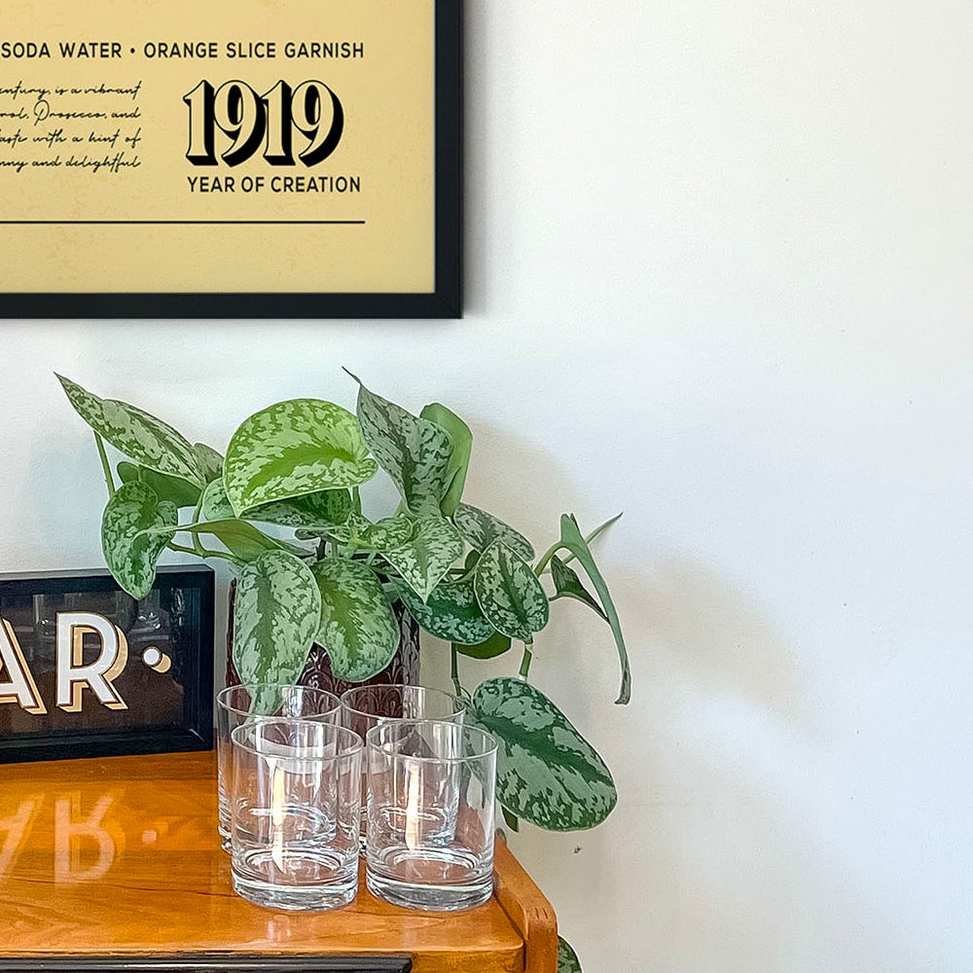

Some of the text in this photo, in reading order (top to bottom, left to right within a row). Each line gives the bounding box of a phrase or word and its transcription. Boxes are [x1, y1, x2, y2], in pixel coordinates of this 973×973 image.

[1, 42, 51, 59] SODA
[58, 42, 122, 59] WATER
[143, 42, 218, 59] ORANGE
[226, 42, 276, 59] SLICE
[284, 42, 364, 59] GARNISH
[54, 85, 69, 96] is
[70, 87, 83, 95] a
[84, 80, 142, 100] vibrant
[110, 107, 142, 118] and
[183, 79, 345, 168] 1919
[32, 128, 68, 148] with
[88, 129, 121, 148] hint
[124, 127, 142, 149] of
[31, 156, 63, 167] and
[65, 151, 142, 173] delightful
[186, 176, 361, 193] YEAR OF CREATION
